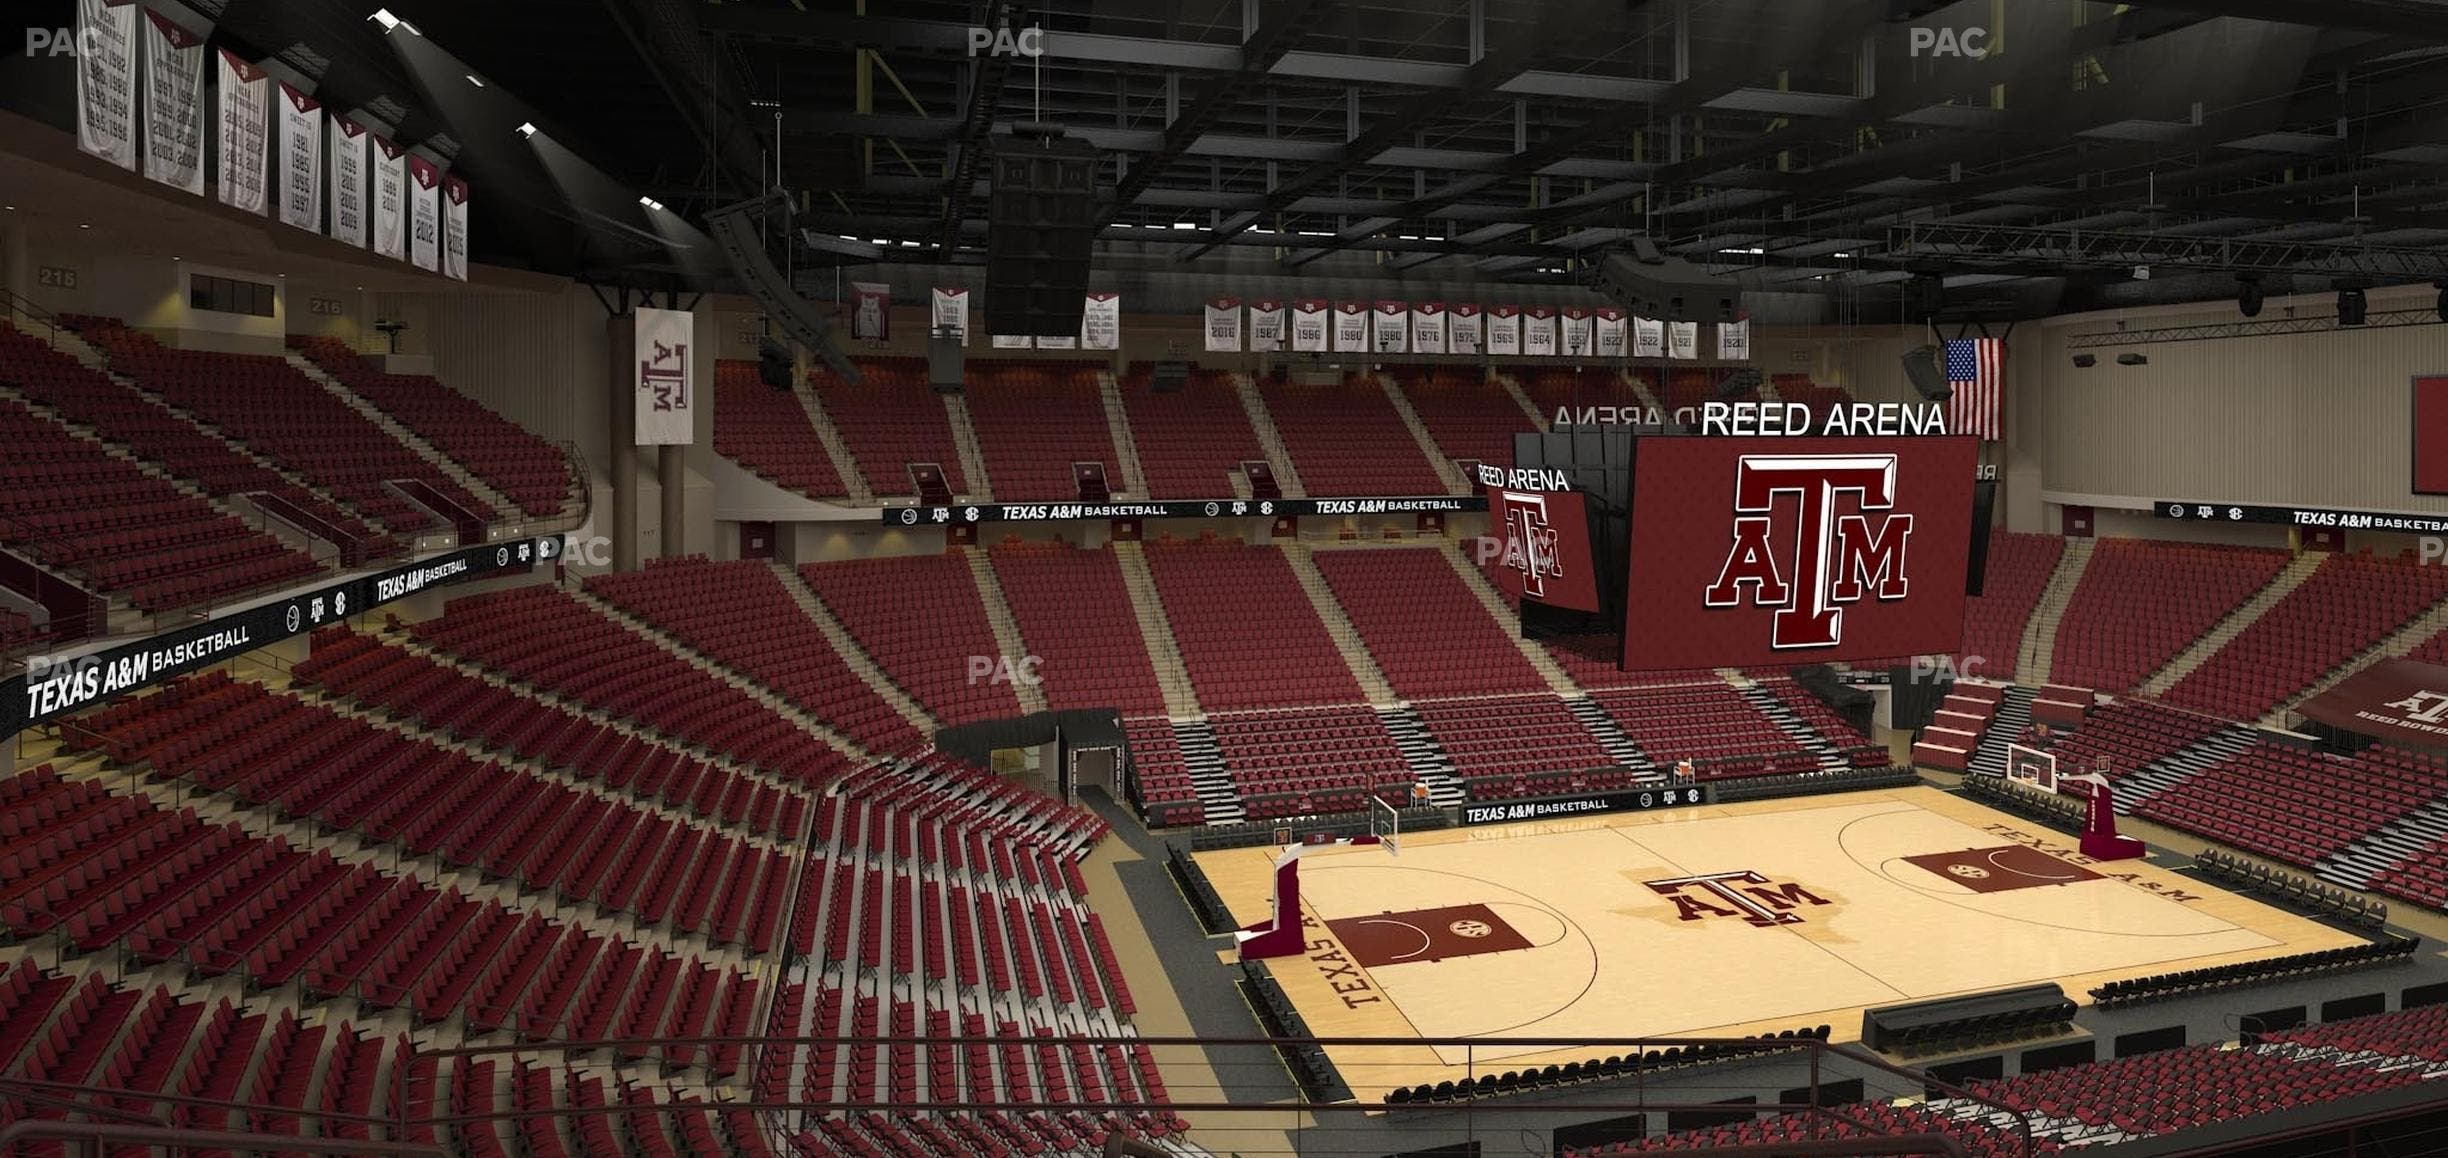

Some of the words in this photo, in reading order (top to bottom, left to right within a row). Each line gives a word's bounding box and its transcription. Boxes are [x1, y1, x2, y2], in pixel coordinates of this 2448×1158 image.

[1211, 326, 1235, 338] 2016
[1255, 327, 1279, 338] 1987
[1340, 330, 1362, 341] 1980
[1379, 330, 1402, 341] 1980
[1417, 330, 1439, 343] 1976
[1455, 331, 1475, 343] 1975
[1529, 333, 1550, 345] 1964
[1639, 335, 1658, 346] 1922
[1702, 401, 1811, 436] REED
[1822, 402, 1946, 436] ARENA
[1478, 464, 1505, 488] REED
[1508, 469, 1570, 491] ARENA
[1002, 506, 1047, 520] TEXAS
[1049, 505, 1082, 519] A&M
[1085, 505, 1167, 517] BASKETBALL
[1316, 501, 1355, 514] TEXAS
[1357, 500, 1386, 513] A&M
[1388, 500, 1461, 511] BASKETBALL
[2293, 511, 2336, 527] TEXAS
[2339, 513, 2372, 528] A&M
[377, 574, 405, 601] TEXAS
[405, 568, 425, 592] A&M
[425, 558, 467, 583] BASKETBALL
[27, 666, 99, 719] TEXAS
[102, 651, 149, 694] A&M
[152, 625, 250, 672] BASKETBALL
[2355, 710, 2399, 726] REED
[1466, 806, 1505, 823] TEXAS
[1507, 803, 1535, 819] A&M
[1537, 799, 1609, 814] BASKETBALL
[1982, 823, 2092, 866] TEXAS
[2106, 872, 2204, 902] A&M
[1305, 939, 1381, 1010] TEXAS
